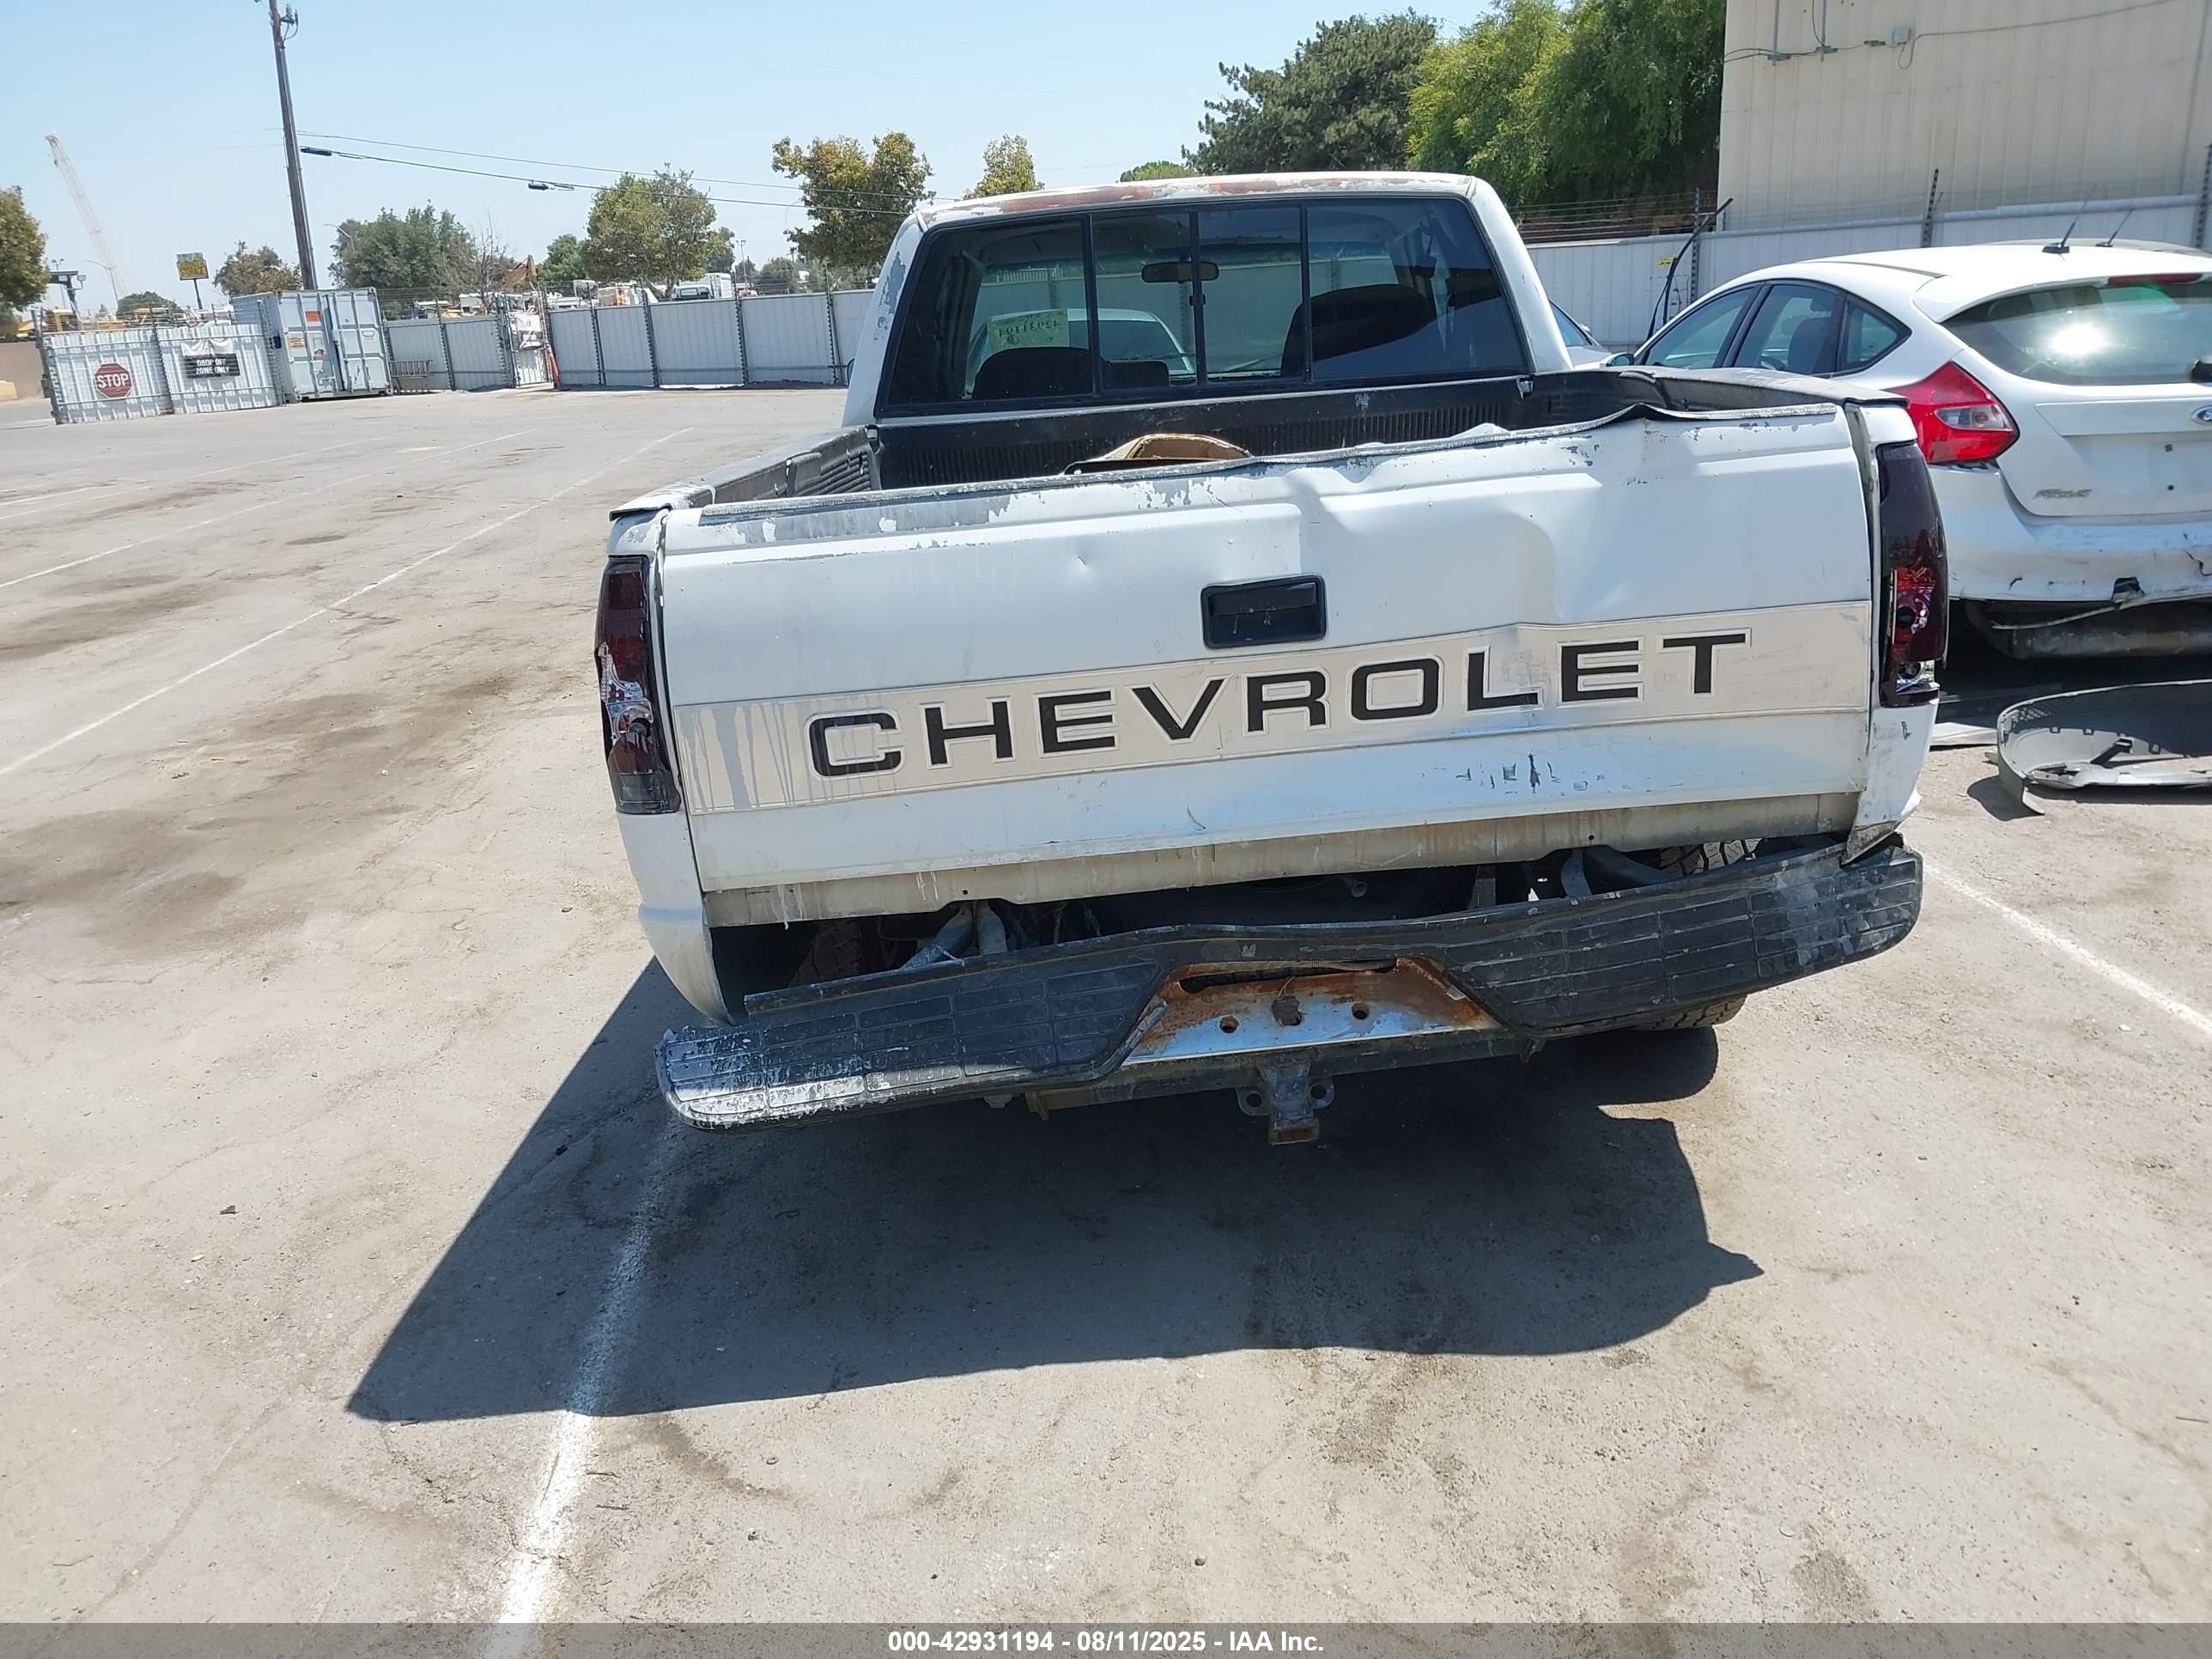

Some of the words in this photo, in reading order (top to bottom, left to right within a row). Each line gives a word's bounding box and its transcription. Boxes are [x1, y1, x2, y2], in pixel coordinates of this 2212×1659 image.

[197, 358, 214, 367] DROP
[215, 357, 227, 366] OFF
[195, 367, 213, 375] ZONE
[214, 365, 229, 374] ONLY
[96, 373, 129, 389] STOP
[808, 631, 1748, 778] CHEVROLET
